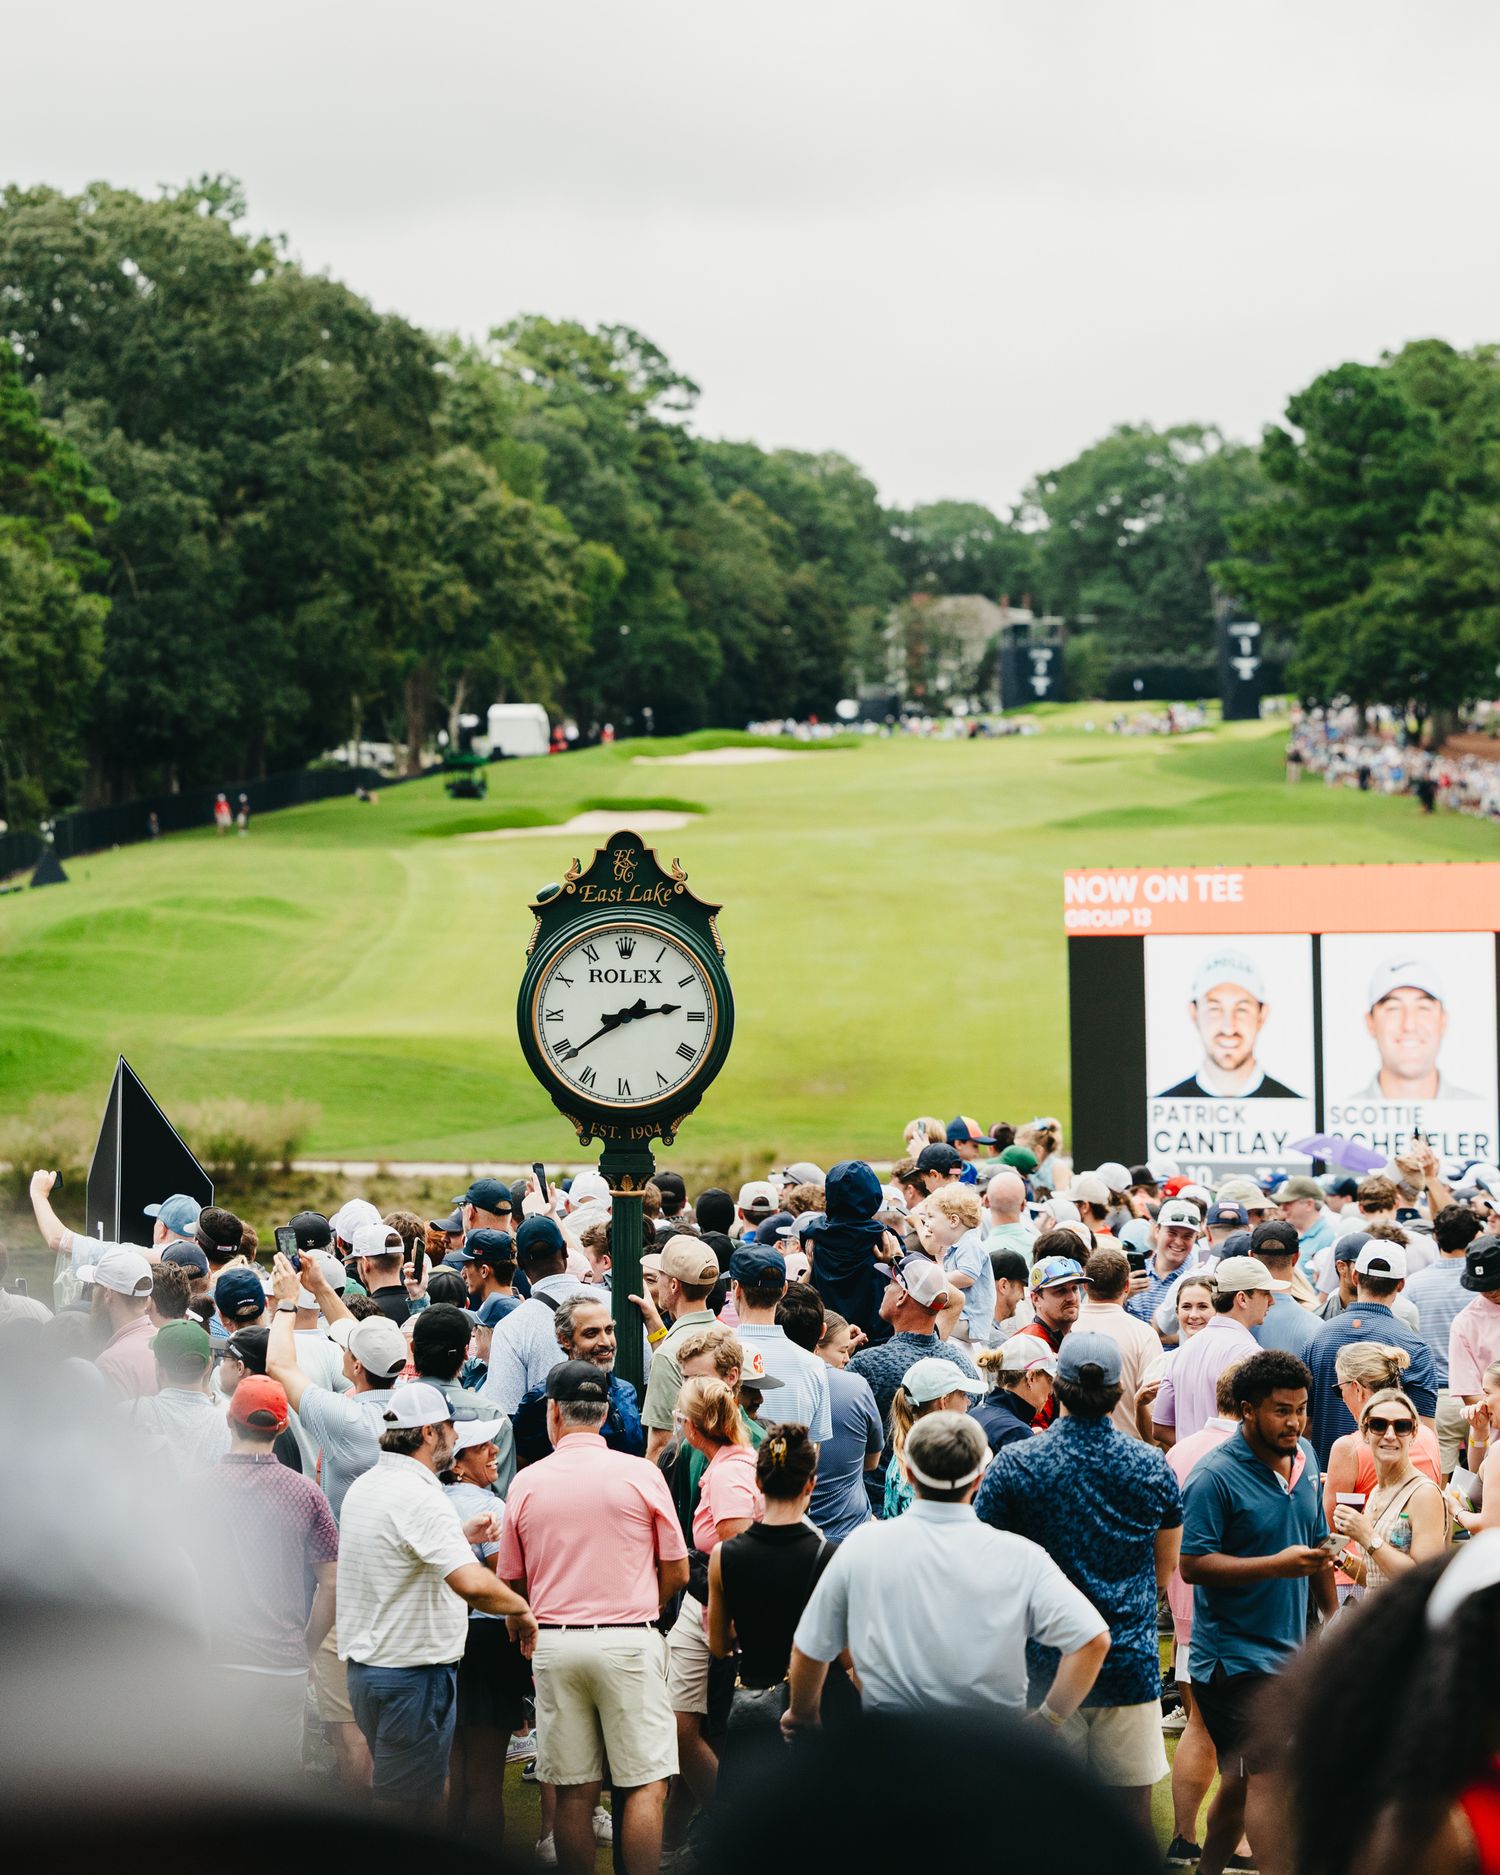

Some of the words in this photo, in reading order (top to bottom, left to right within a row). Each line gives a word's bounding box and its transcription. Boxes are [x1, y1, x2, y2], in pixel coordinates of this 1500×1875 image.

[579, 885, 623, 902] East
[626, 882, 672, 907] Lake
[1064, 875, 1138, 903] NOW
[1143, 874, 1189, 903] ON
[1194, 873, 1243, 902] TEE
[1064, 908, 1130, 928] GROUP
[589, 968, 662, 983] ROLEX
[1152, 1105, 1247, 1124] PATRICK
[1330, 1106, 1423, 1124] SCOTTIE
[590, 1122, 622, 1139] EST.
[630, 1122, 662, 1140] 1904
[1154, 1131, 1288, 1154] CANTLAY
[1331, 1132, 1489, 1157] HEFLER
